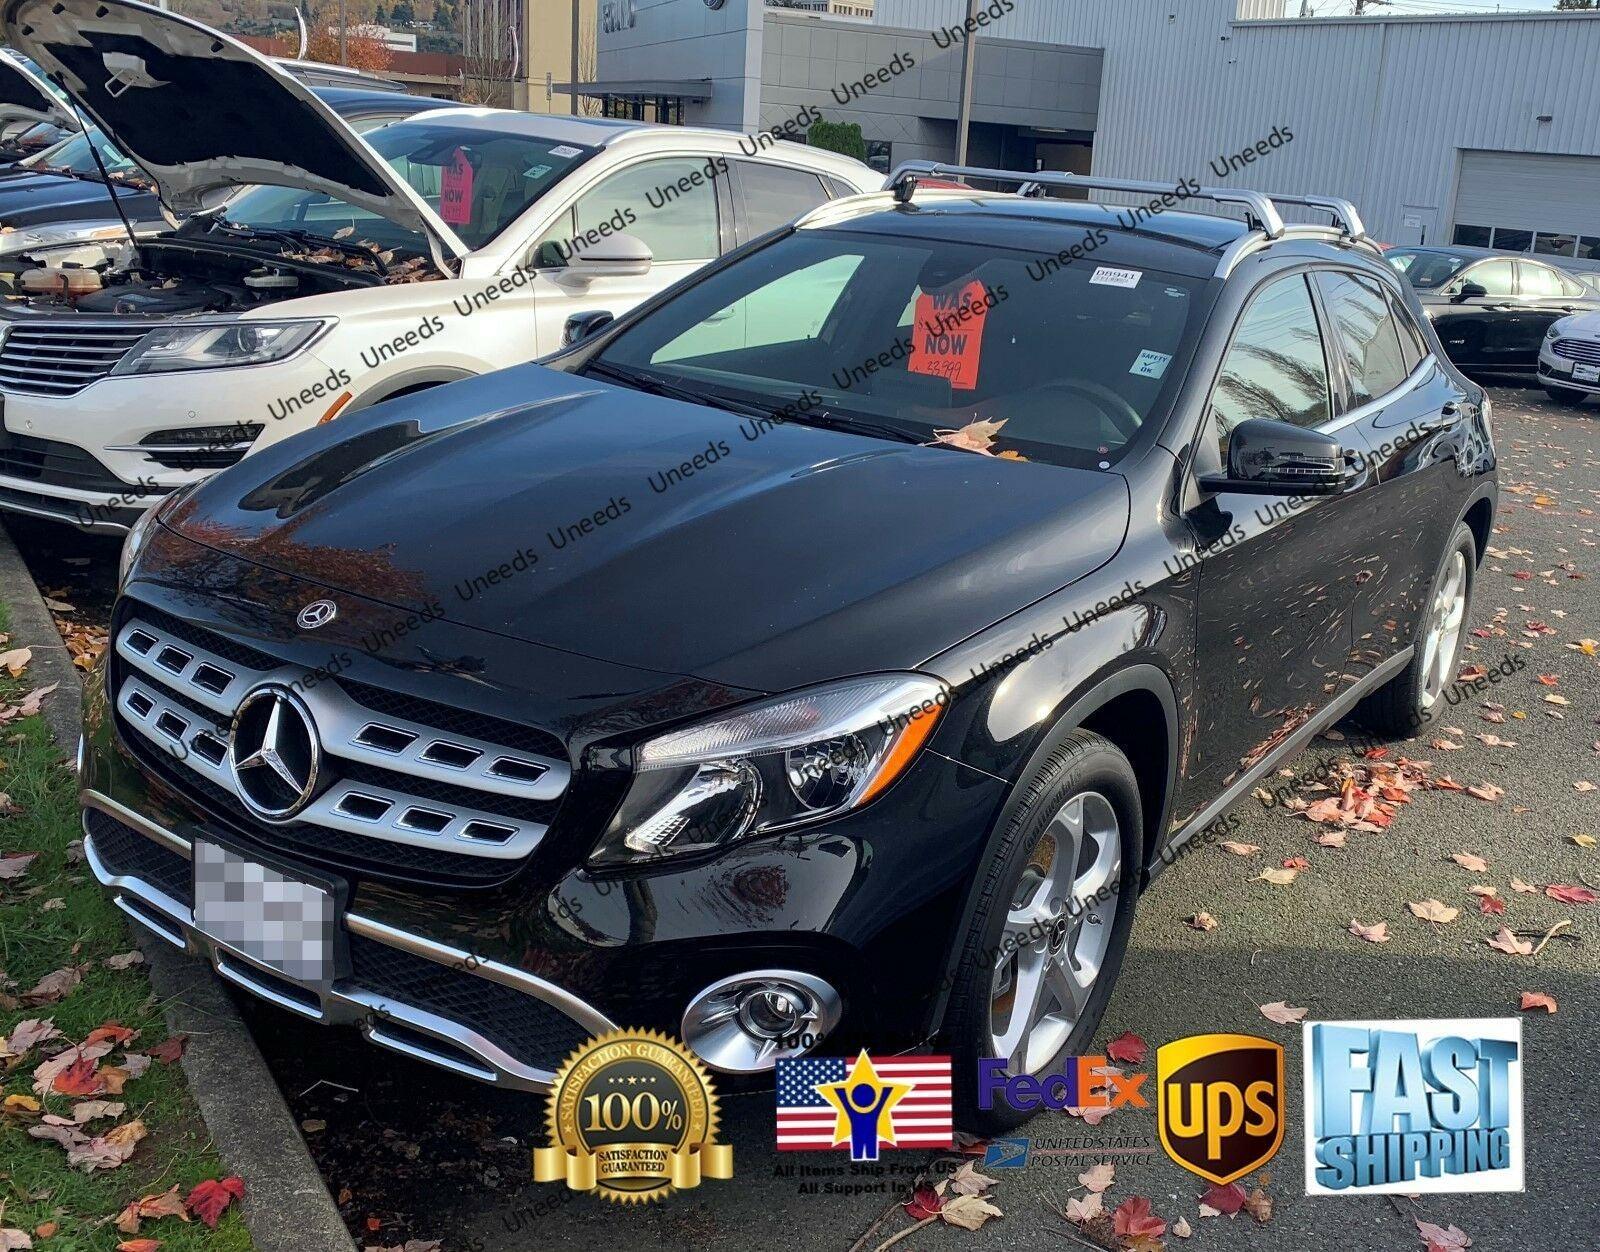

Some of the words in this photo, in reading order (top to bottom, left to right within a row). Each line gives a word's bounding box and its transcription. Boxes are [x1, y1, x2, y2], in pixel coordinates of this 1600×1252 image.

[932, 291, 973, 311] WAS
[925, 333, 968, 356] NOW
[1141, 353, 1168, 363] SAFETY
